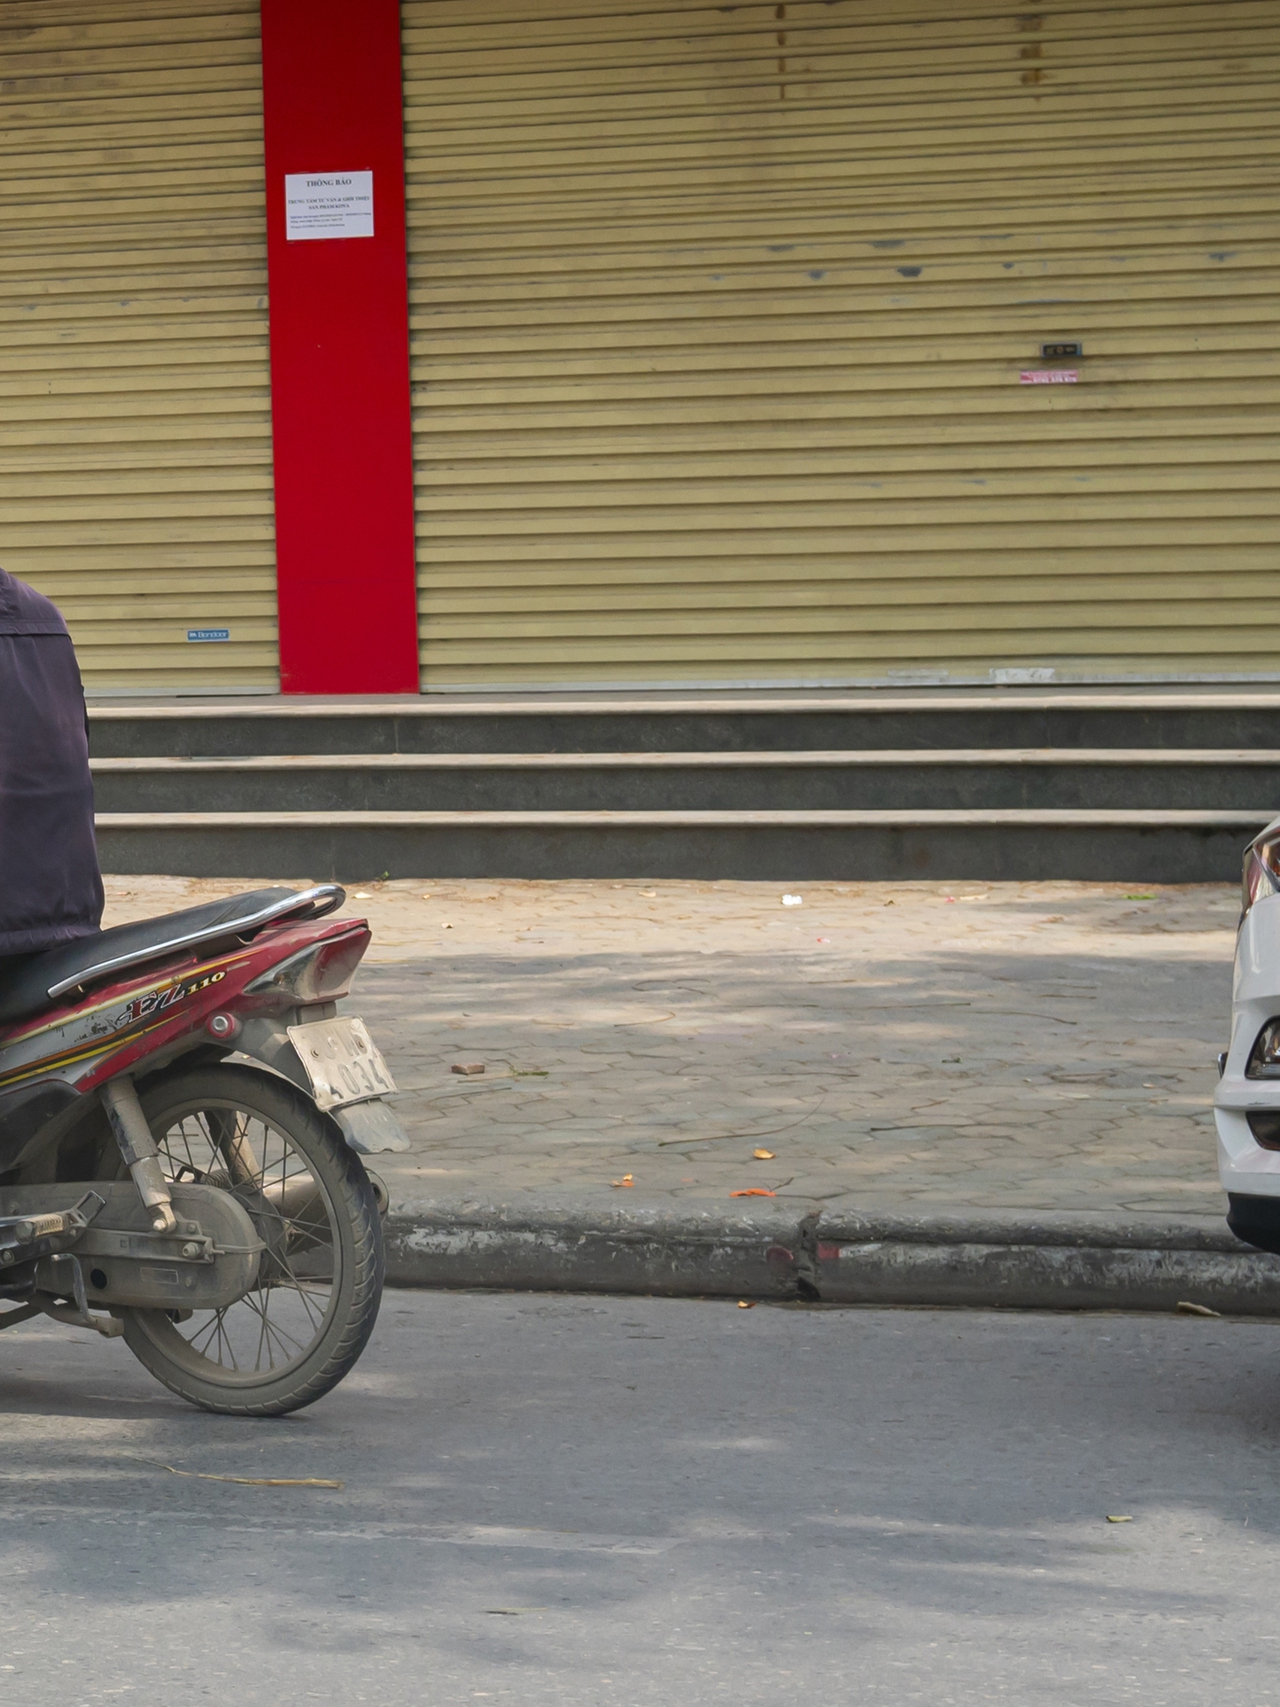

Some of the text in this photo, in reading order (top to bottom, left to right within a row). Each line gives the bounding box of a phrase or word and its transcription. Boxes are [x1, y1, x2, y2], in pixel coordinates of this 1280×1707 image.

[306, 177, 352, 187] THÔNG BÁO
[187, 971, 226, 996] 110
